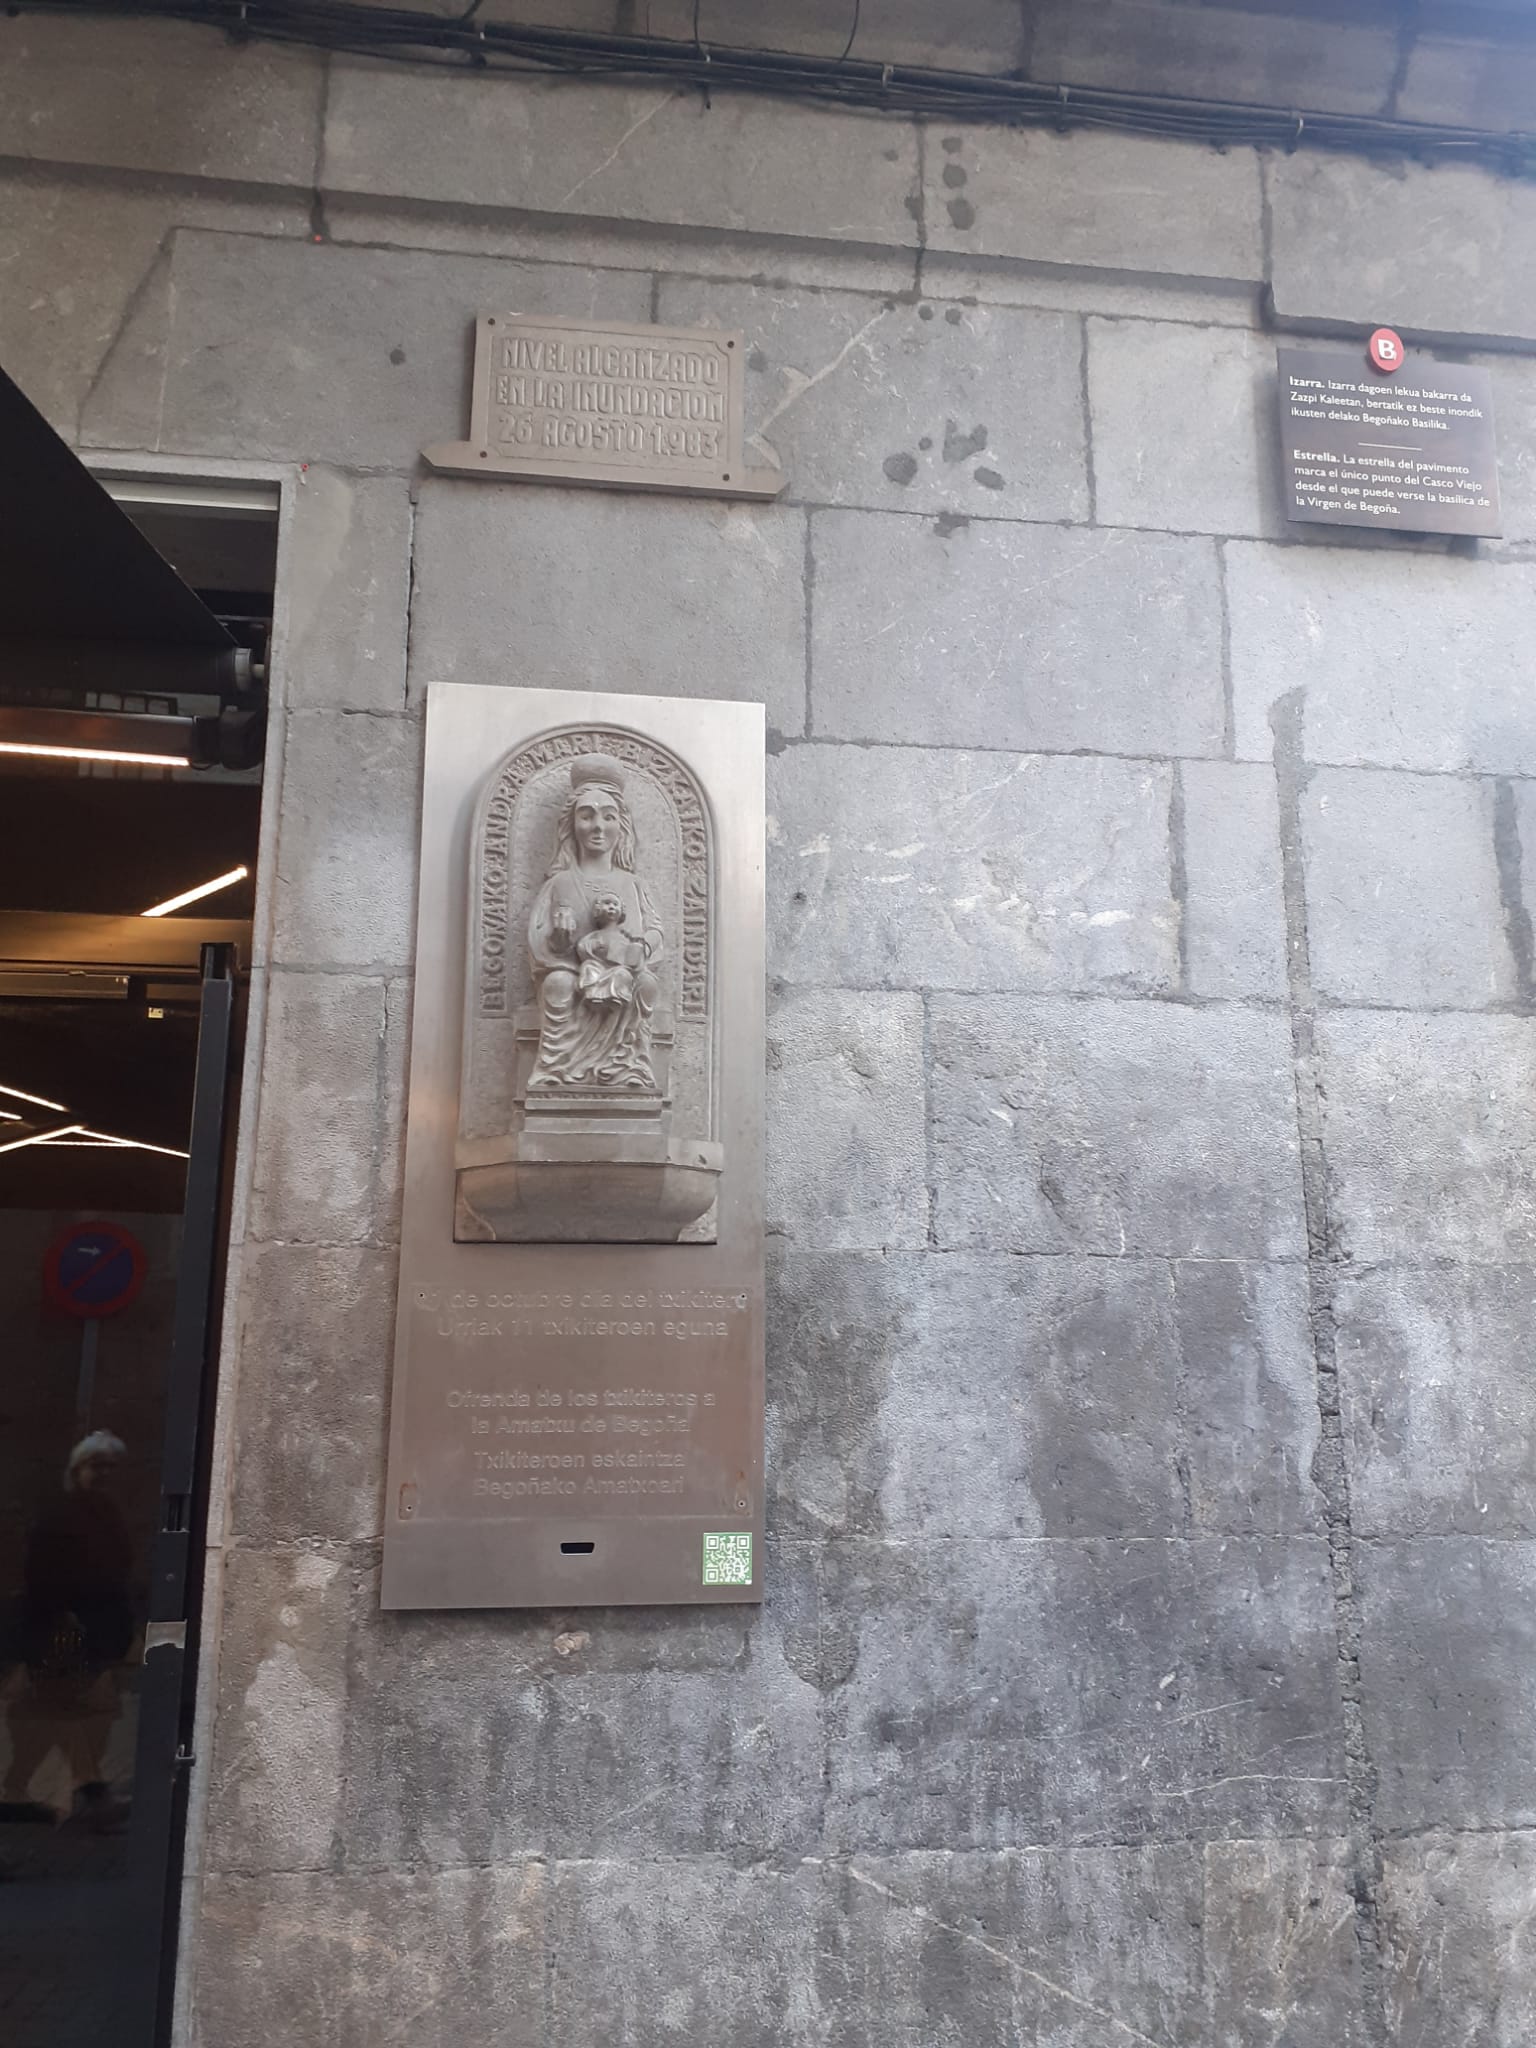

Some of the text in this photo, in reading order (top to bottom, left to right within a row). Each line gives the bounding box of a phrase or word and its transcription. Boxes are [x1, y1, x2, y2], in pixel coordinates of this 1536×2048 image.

[501, 337, 720, 386] NIVEL ALCANZADO
[495, 375, 725, 423] EN LA INUNDACION
[1289, 376, 1472, 402] Izarra. Izarra dagoen lekua bakarra da
[1290, 392, 1317, 405] Zazpi
[1320, 394, 1364, 408] Kaleetan,
[1367, 398, 1404, 410] bertatik
[1420, 402, 1446, 415] beste
[1448, 407, 1483, 418] inondik
[1291, 407, 1450, 430] ikusten delako Begoñako Basilika.
[498, 411, 533, 445] 26
[541, 414, 643, 452] AGOSTO
[1294, 450, 1469, 474] Estrella. La estrella del pavimento
[1295, 467, 1482, 492] marca el único punto del Casco Viejo
[1296, 481, 1490, 507] desde el que puede verse la basílica de
[1296, 496, 1401, 514] la Virgen de Begoña.
[681, 874, 708, 1016] ZAINDARI
[543, 1318, 655, 1336] txikiteroen
[663, 1321, 728, 1341] eguna
[447, 1390, 716, 1408] Ofrenda de los txikiteros a
[471, 1416, 489, 1435] la
[580, 1416, 607, 1433] de
[613, 1416, 691, 1437] Begoña
[474, 1450, 686, 1469] Txikiteroen eskaintza
[474, 1476, 685, 1499] Begoñako Amatxoari
